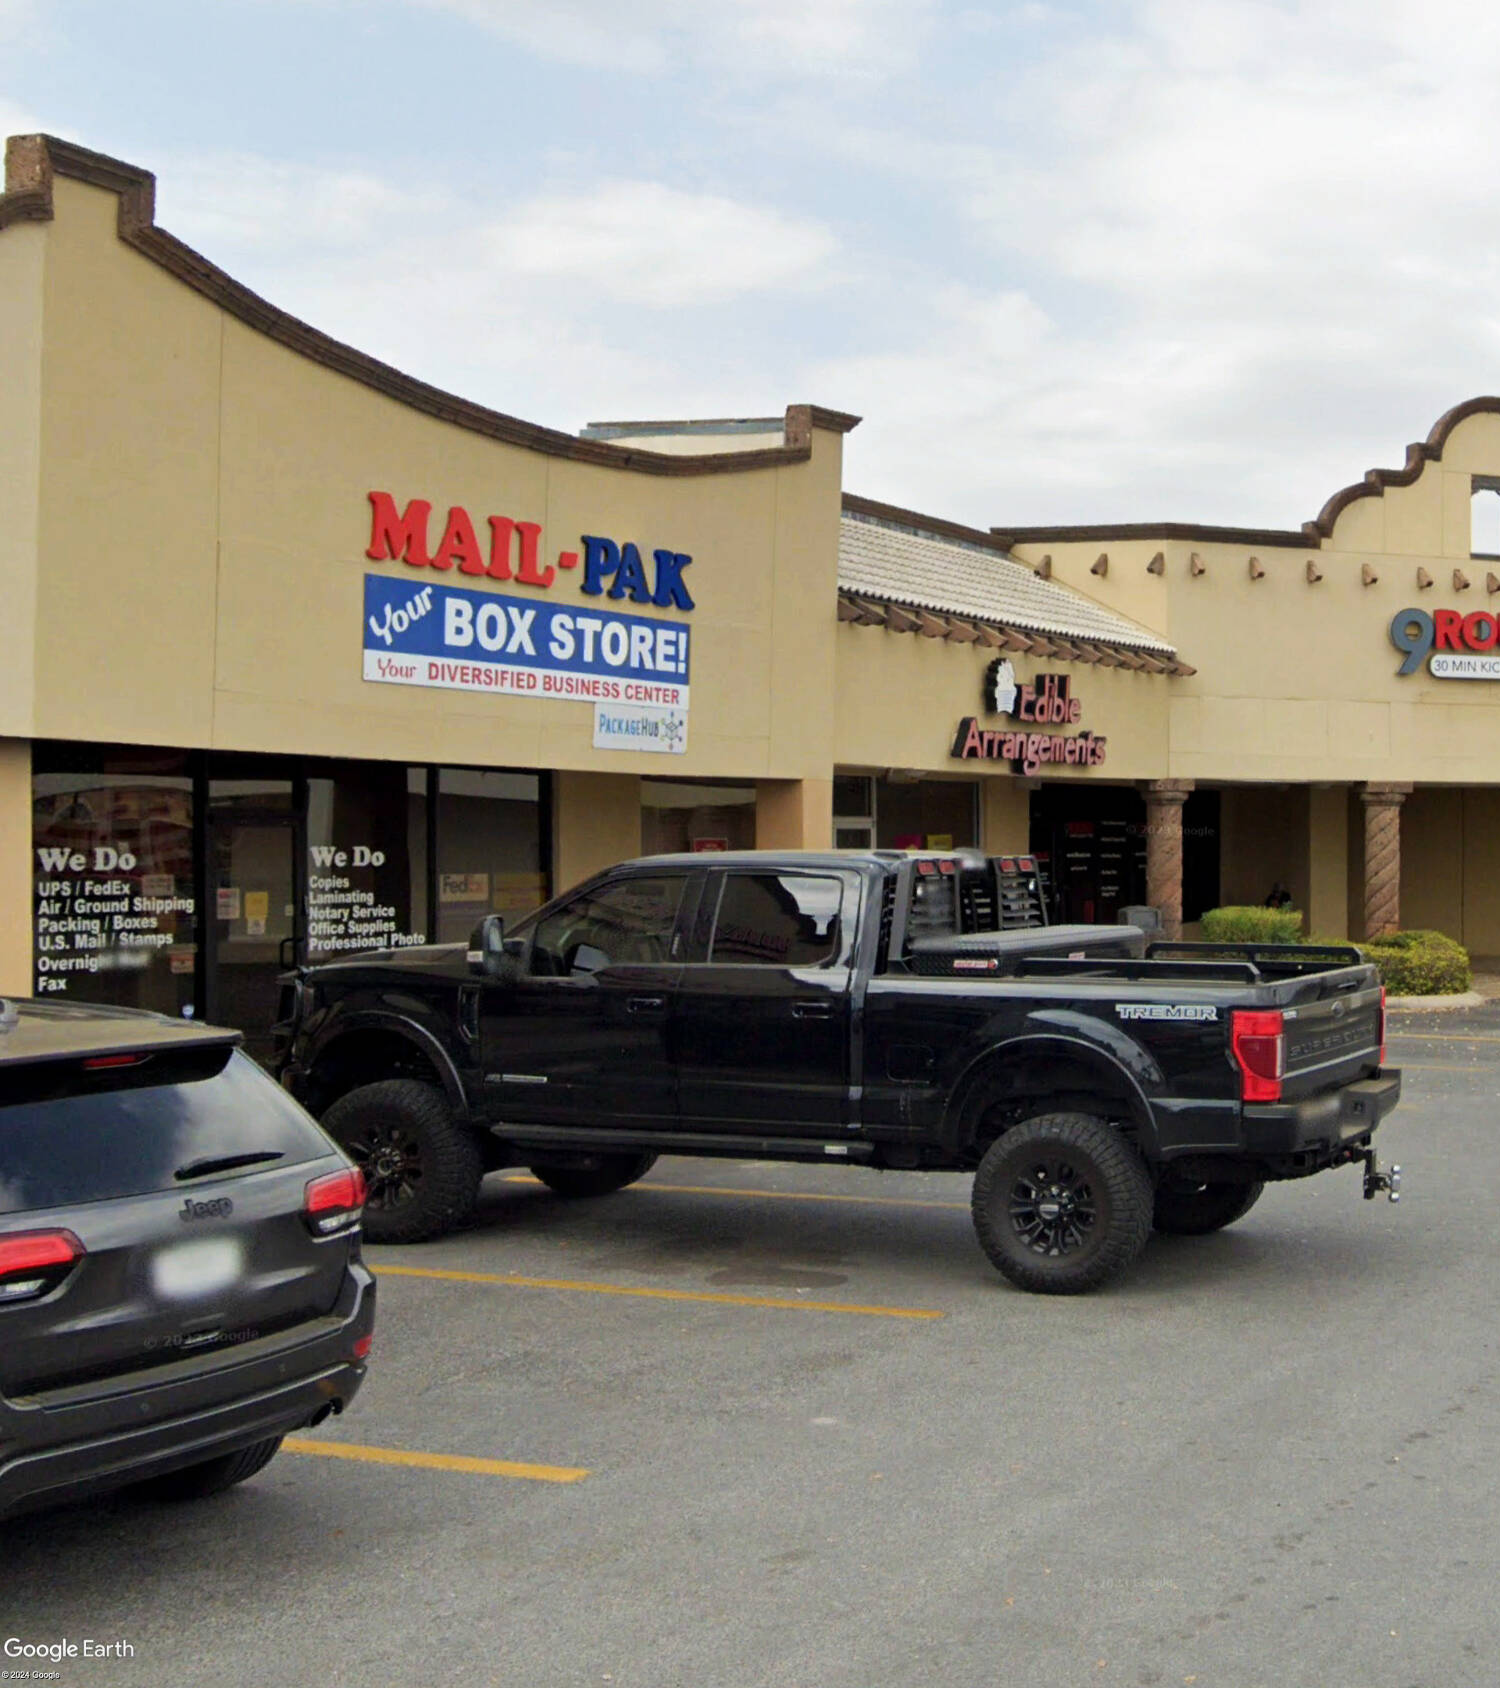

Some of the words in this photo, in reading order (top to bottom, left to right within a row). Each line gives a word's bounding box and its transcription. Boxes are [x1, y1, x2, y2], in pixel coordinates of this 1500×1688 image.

[365, 490, 695, 611] MAIL-PAK
[369, 586, 433, 645] Your
[444, 597, 536, 656] BOX
[549, 614, 688, 674] STORE!
[1434, 659, 1448, 672] 30
[1452, 660, 1477, 673] MIN
[377, 658, 416, 679] Your
[428, 662, 537, 690] DIVERSIFIED
[543, 676, 620, 699] BUSINESS
[625, 684, 680, 705] CENTER
[1018, 674, 1081, 723] Edible
[959, 717, 1106, 777] Arrangements
[37, 847, 87, 872] We
[93, 847, 137, 871] Do
[310, 846, 348, 867] We
[352, 846, 385, 867] Do
[38, 881, 71, 896] UPS
[84, 880, 130, 895] FedEx
[309, 875, 350, 891] Copies
[38, 900, 62, 915] Air
[74, 899, 129, 914] Ground
[133, 897, 194, 914] Shipping
[309, 890, 374, 905] Laminating
[309, 907, 350, 921] Notary
[352, 904, 395, 918] Service
[38, 916, 100, 934] Packing
[112, 915, 158, 930] Boxes
[309, 922, 345, 935] Office
[348, 919, 396, 936] Supplies
[38, 935, 70, 950] U.S.
[75, 933, 106, 949] Mail
[119, 932, 173, 948] Stamps
[309, 934, 387, 951] Professional
[391, 932, 425, 946] Photo
[38, 976, 67, 992] Fax
[1115, 1003, 1218, 1021] TREMOR
[179, 1197, 234, 1222] Jeep
